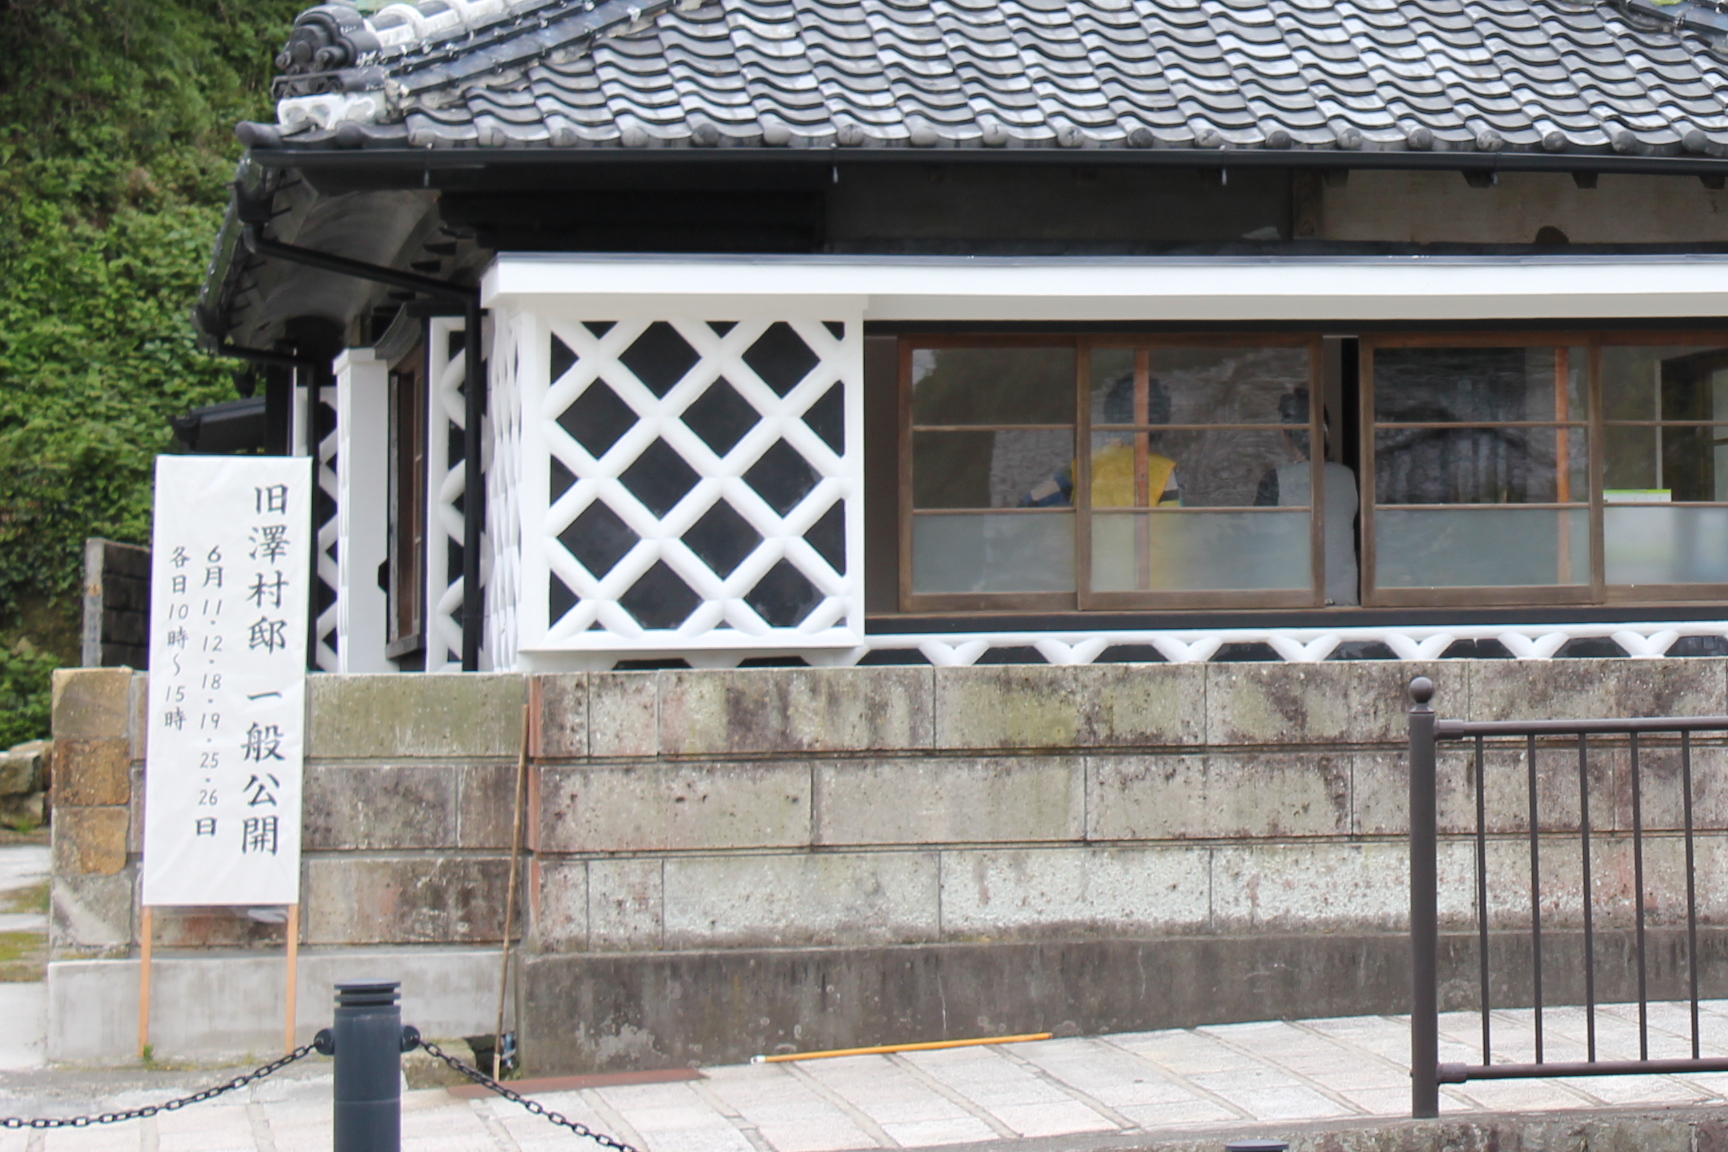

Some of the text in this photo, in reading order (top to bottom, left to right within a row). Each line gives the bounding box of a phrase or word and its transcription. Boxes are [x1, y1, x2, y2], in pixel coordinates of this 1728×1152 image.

[240, 483, 290, 857] 旧澤村邸 一般公開
